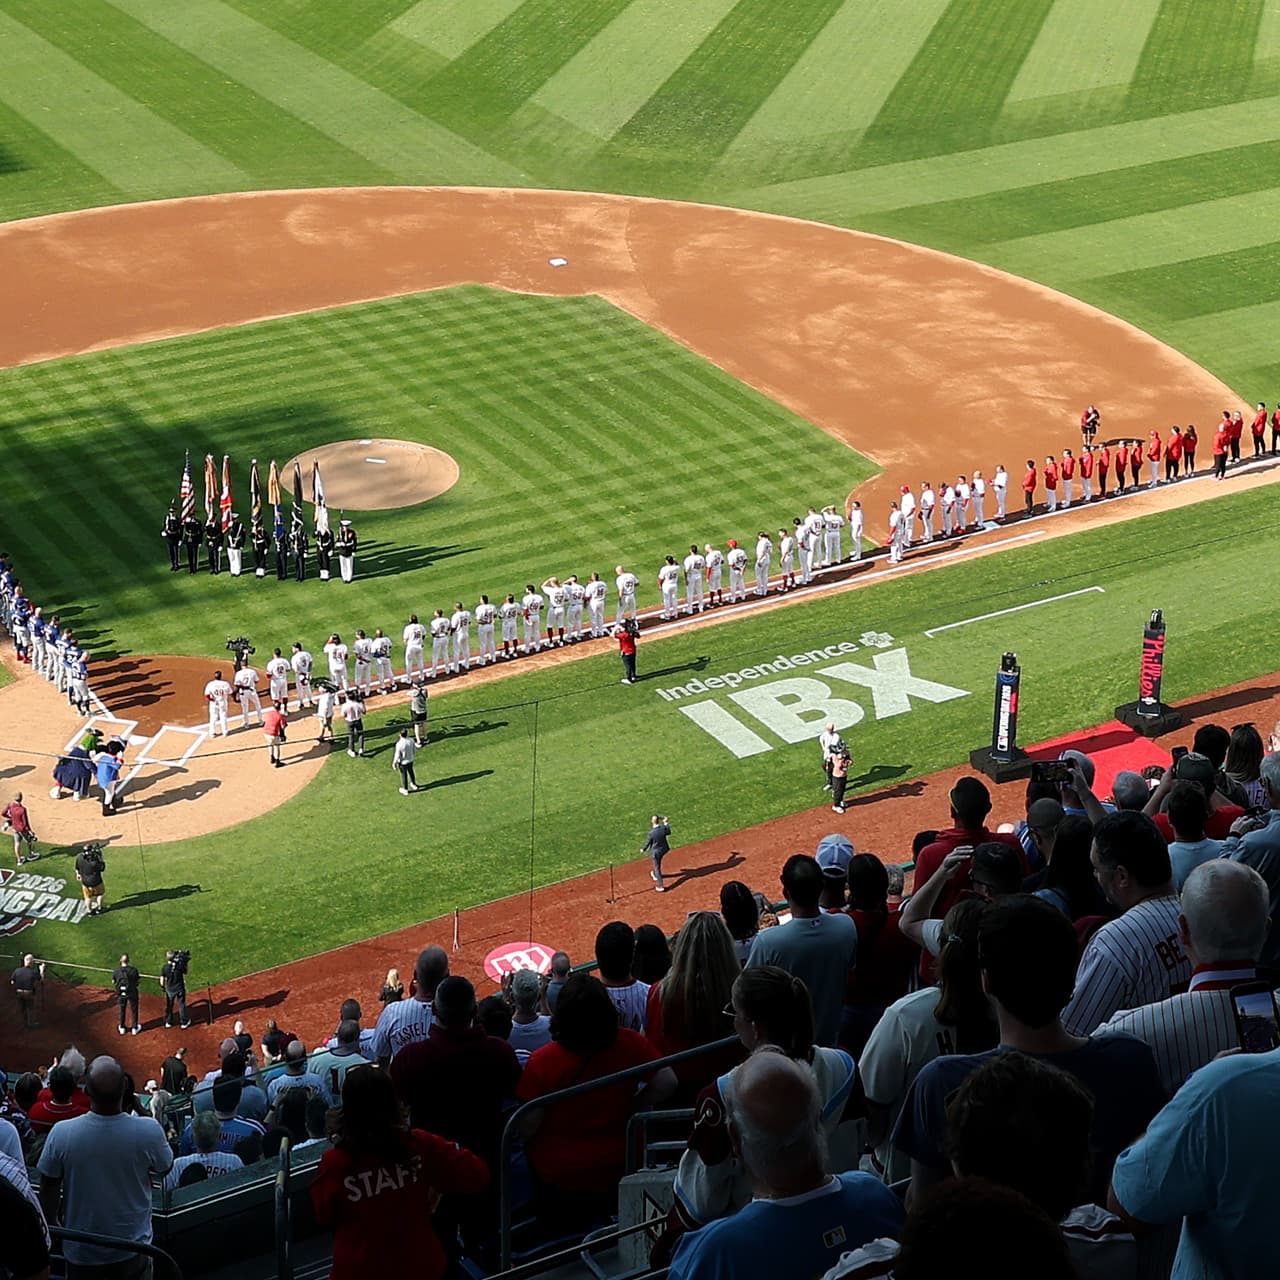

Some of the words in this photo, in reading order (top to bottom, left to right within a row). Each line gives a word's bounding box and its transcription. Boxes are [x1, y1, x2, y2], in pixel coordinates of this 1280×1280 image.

[656, 639, 859, 702] Independence
[1141, 635, 1165, 697] Phillies
[678, 646, 972, 760] IBX
[13, 873, 69, 893] 2026
[24, 894, 98, 924] DAY
